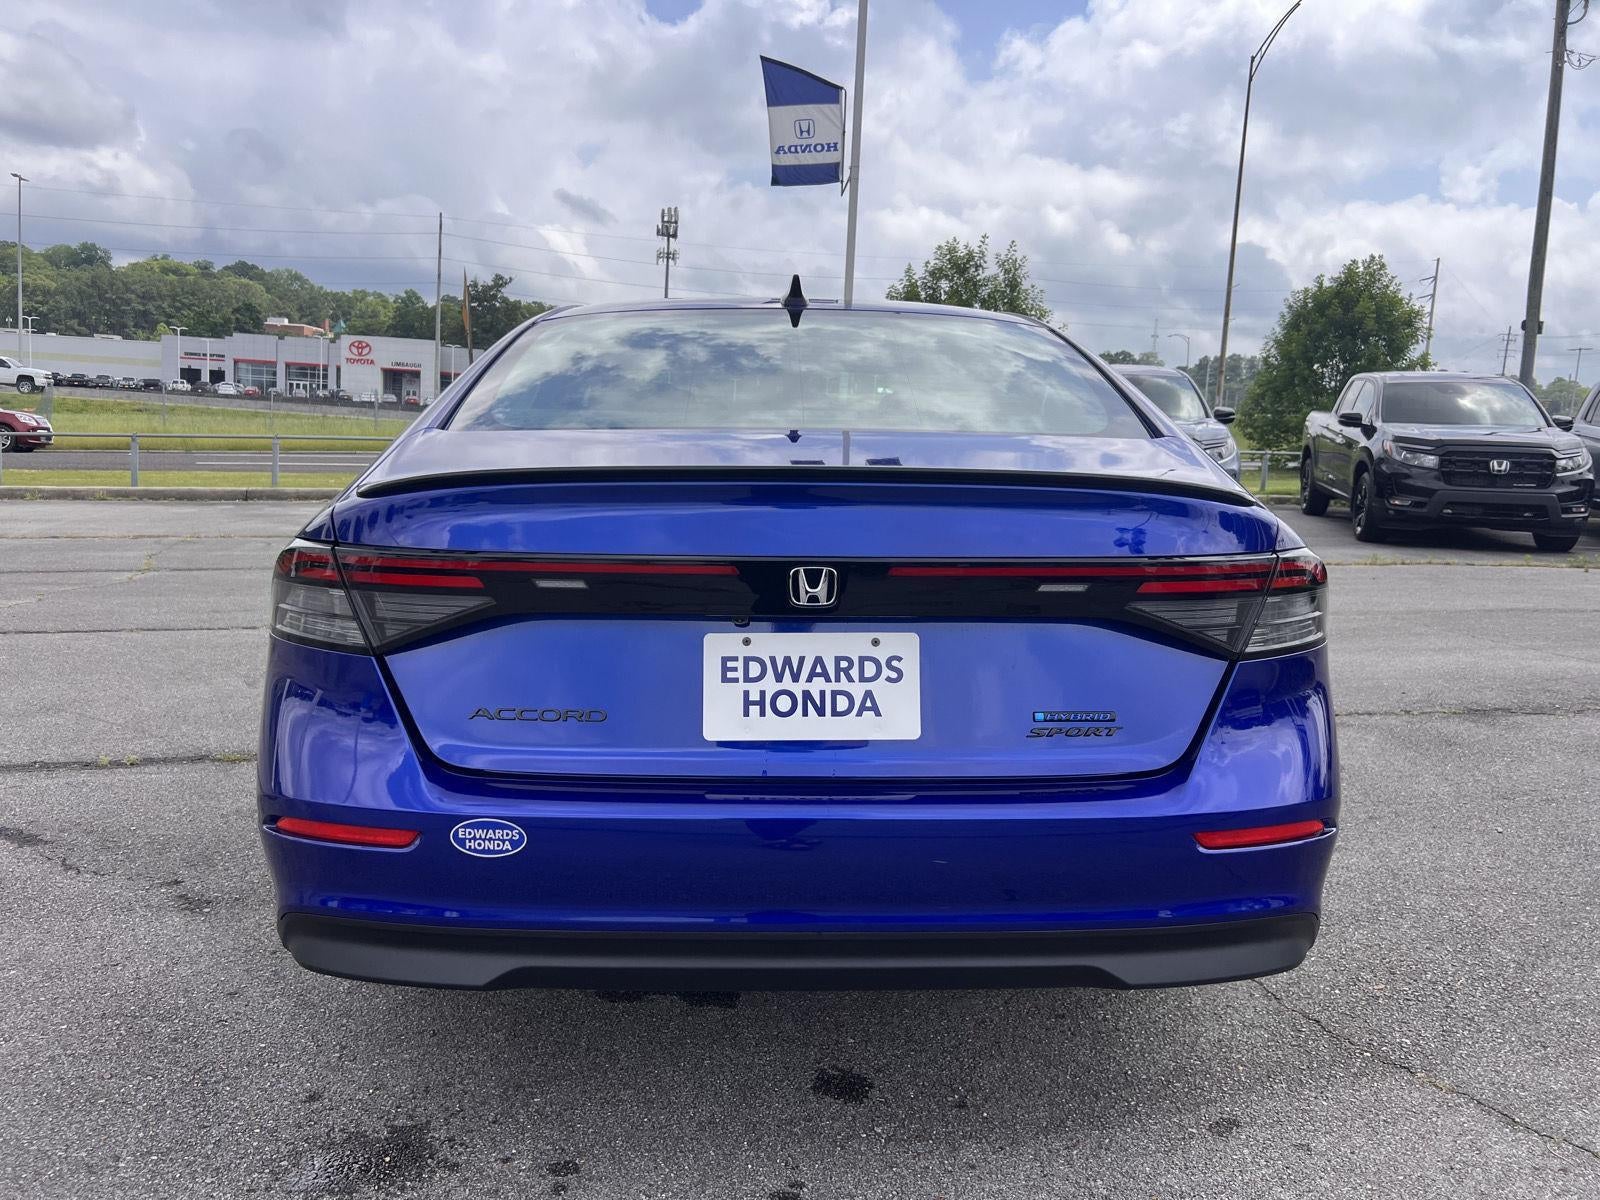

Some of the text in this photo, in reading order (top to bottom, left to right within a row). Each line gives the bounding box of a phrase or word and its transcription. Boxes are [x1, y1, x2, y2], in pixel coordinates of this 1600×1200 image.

[345, 358, 375, 366] TOYOTA
[720, 655, 904, 684] EDWARDS
[742, 689, 883, 718] HONDA
[468, 707, 608, 723] ACCORD
[1046, 712, 1111, 722] HYBRID
[1026, 727, 1123, 738] SPORT
[458, 827, 520, 841] EDWARDS
[465, 839, 513, 851] HONDA
